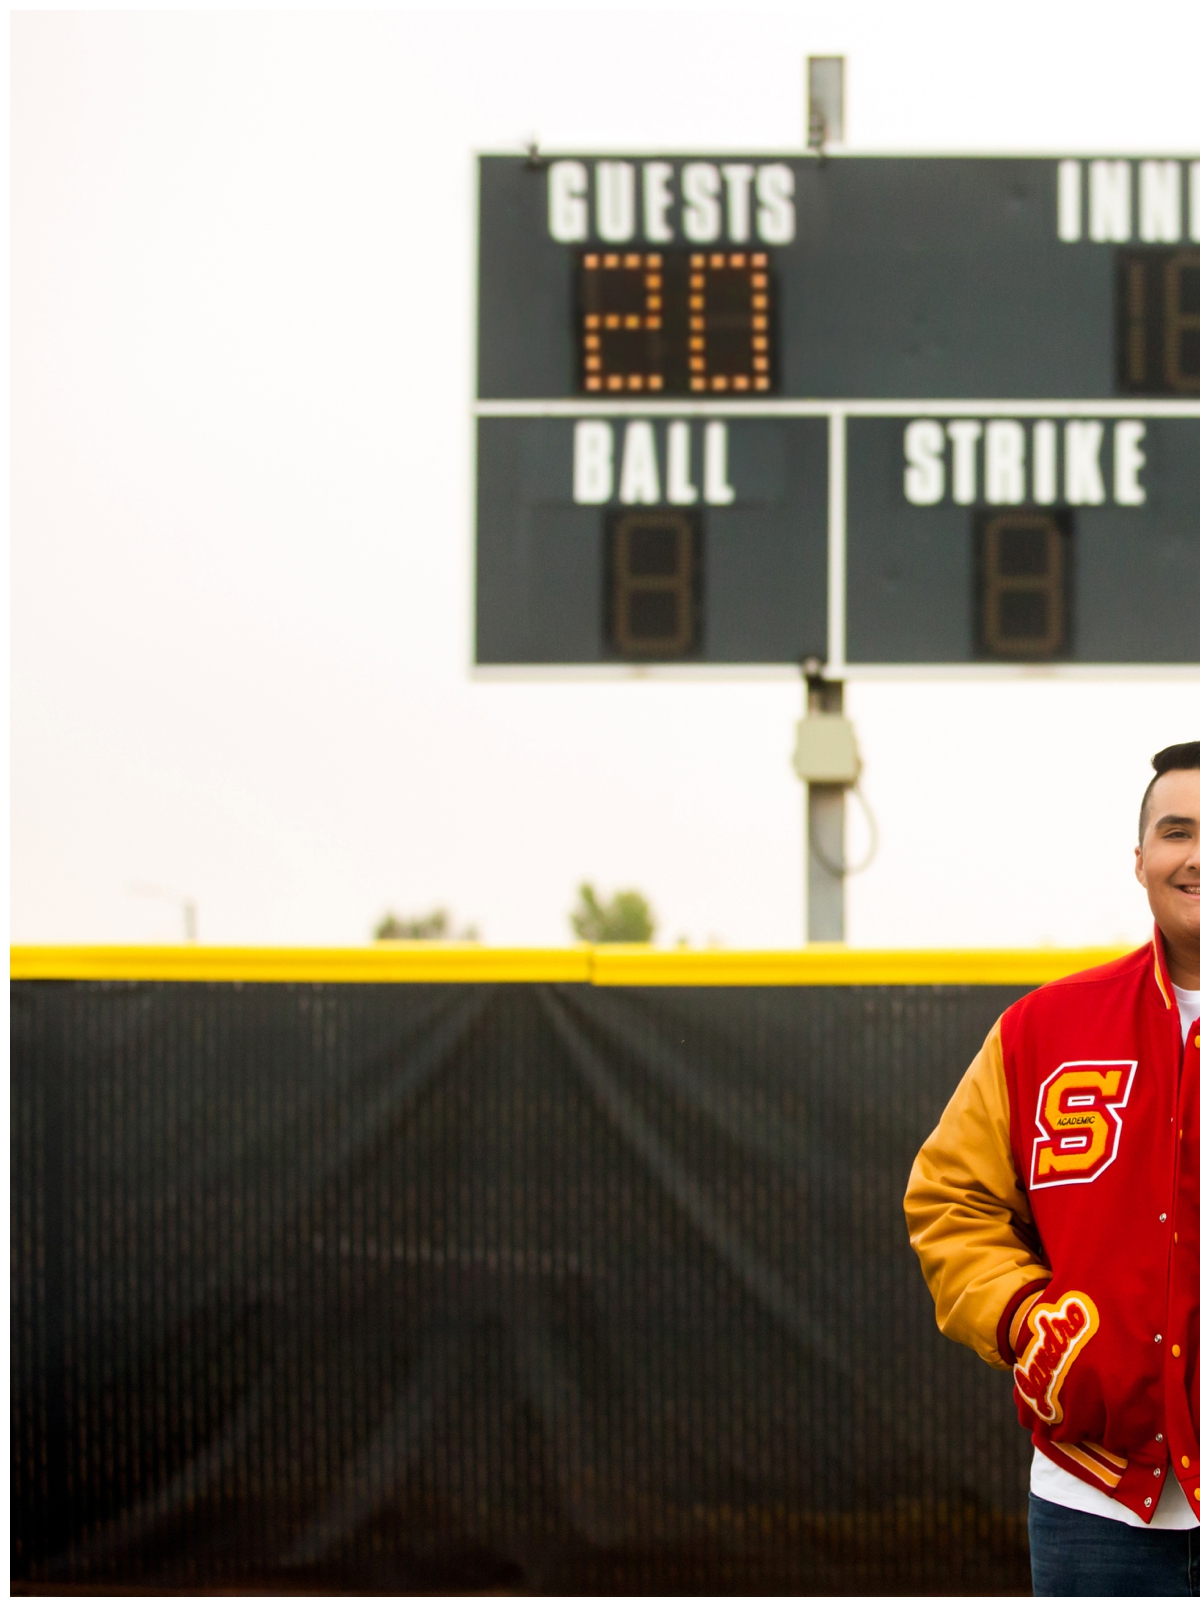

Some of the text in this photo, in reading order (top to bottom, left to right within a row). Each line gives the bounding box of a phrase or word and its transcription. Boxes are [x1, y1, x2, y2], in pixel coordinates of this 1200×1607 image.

[548, 161, 796, 244] GUESTS
[584, 253, 770, 391] 20
[573, 420, 735, 505] BALL
[903, 420, 1147, 506] STRIKE
[1030, 1060, 1138, 1190] S
[1056, 1116, 1096, 1126] ACADEMIC
